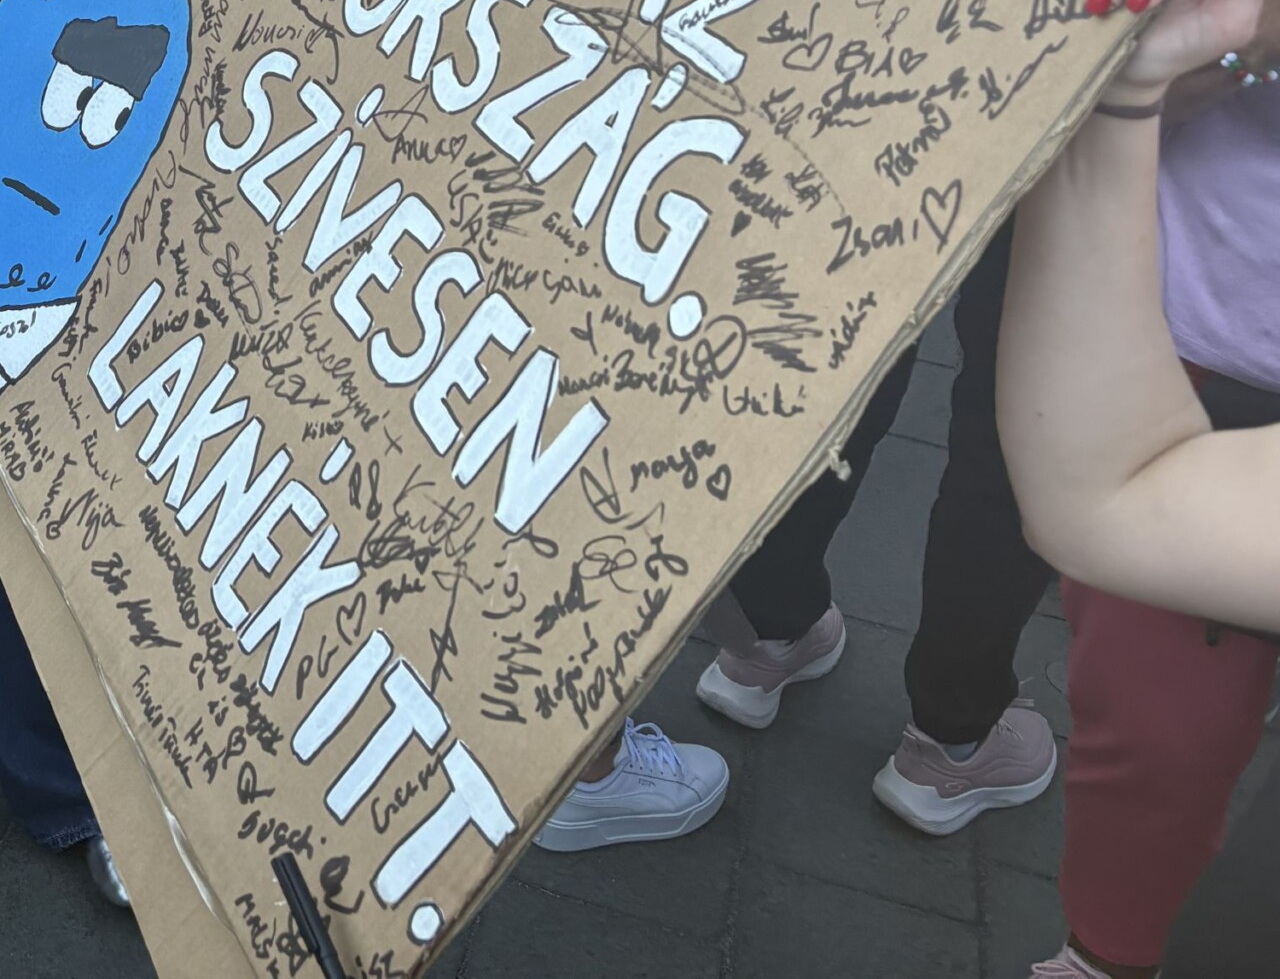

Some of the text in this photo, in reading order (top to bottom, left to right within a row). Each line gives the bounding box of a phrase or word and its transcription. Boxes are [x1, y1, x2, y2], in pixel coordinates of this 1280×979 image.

[202, 47, 609, 535] SZÍVESEN
[85, 278, 361, 694] LAKNÉK
[289, 627, 517, 942] ITT.
